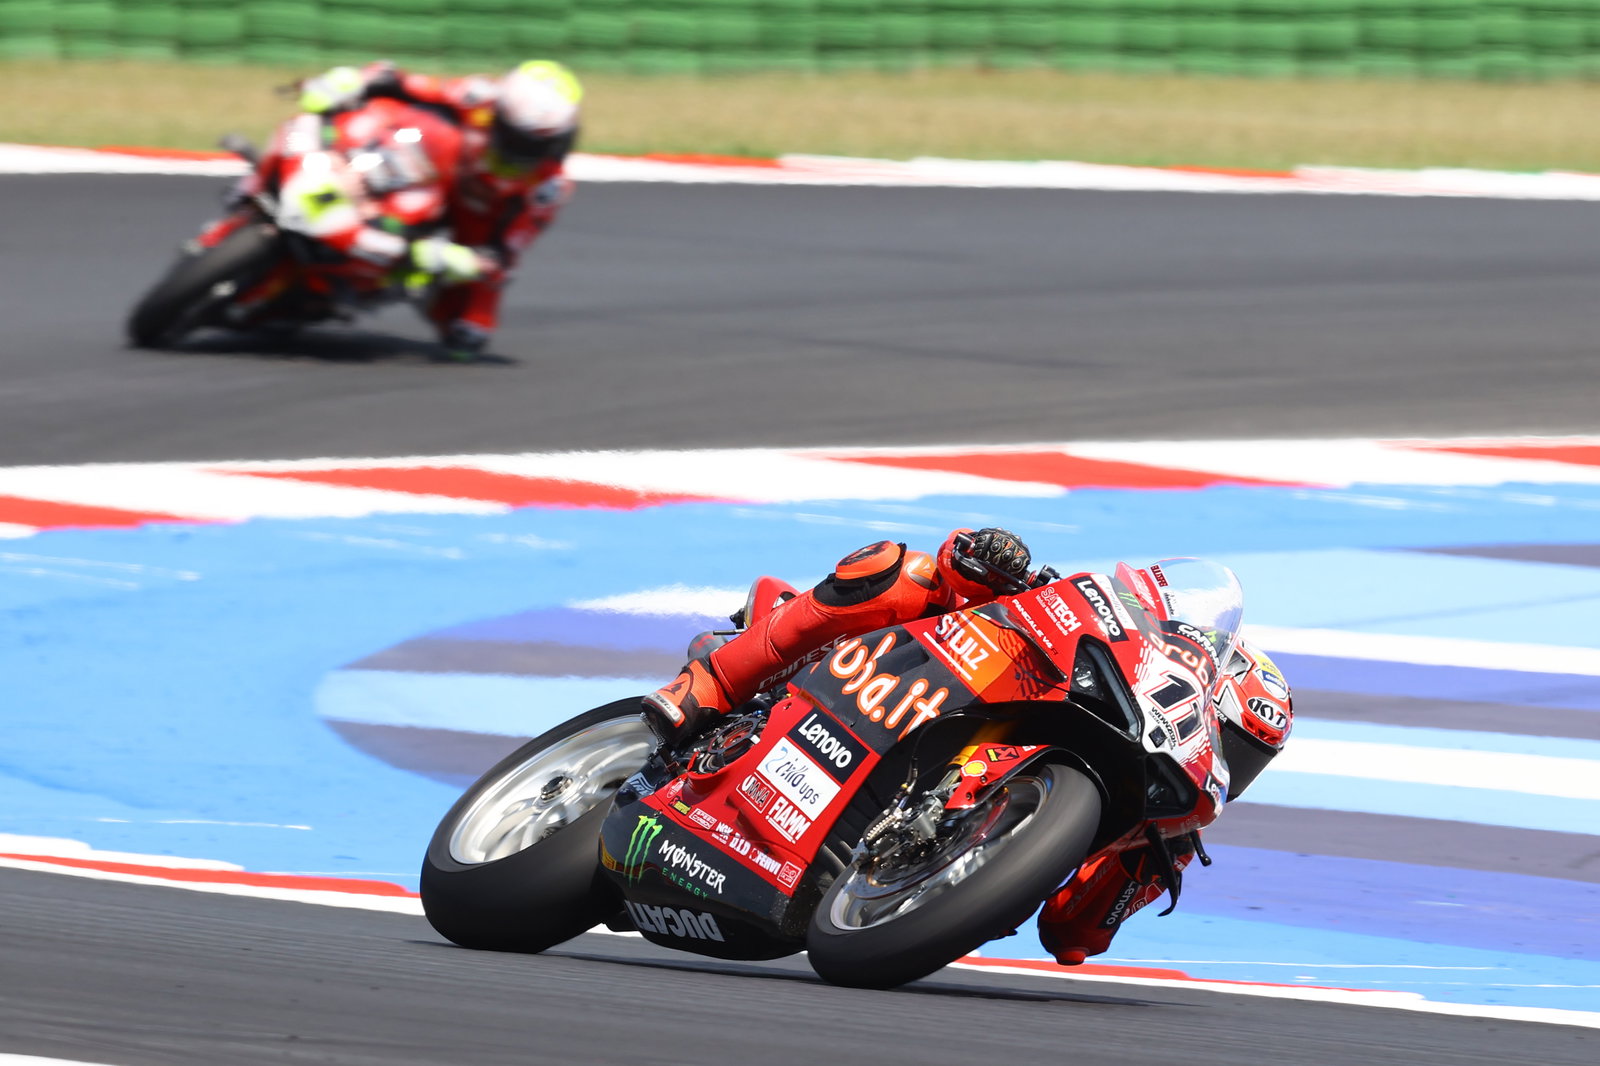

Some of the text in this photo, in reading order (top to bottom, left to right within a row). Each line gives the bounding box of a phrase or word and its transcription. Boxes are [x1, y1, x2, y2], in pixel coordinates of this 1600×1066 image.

[1012, 599, 1044, 638] PANIGALE
[1041, 587, 1082, 632] SATECH
[1077, 580, 1120, 636] Lenovo
[935, 615, 989, 670] STULZ
[1148, 631, 1211, 690] arub
[827, 632, 948, 741] uba.it
[1247, 698, 1286, 726] KYT
[798, 713, 852, 768] Lenovo
[799, 783, 820, 804] ups
[767, 796, 812, 841] FIAMM
[662, 867, 709, 898] ENERGY
[755, 851, 782, 875] FERVI
[624, 900, 725, 942] DUCATI
[1105, 880, 1137, 925] Lenovo
